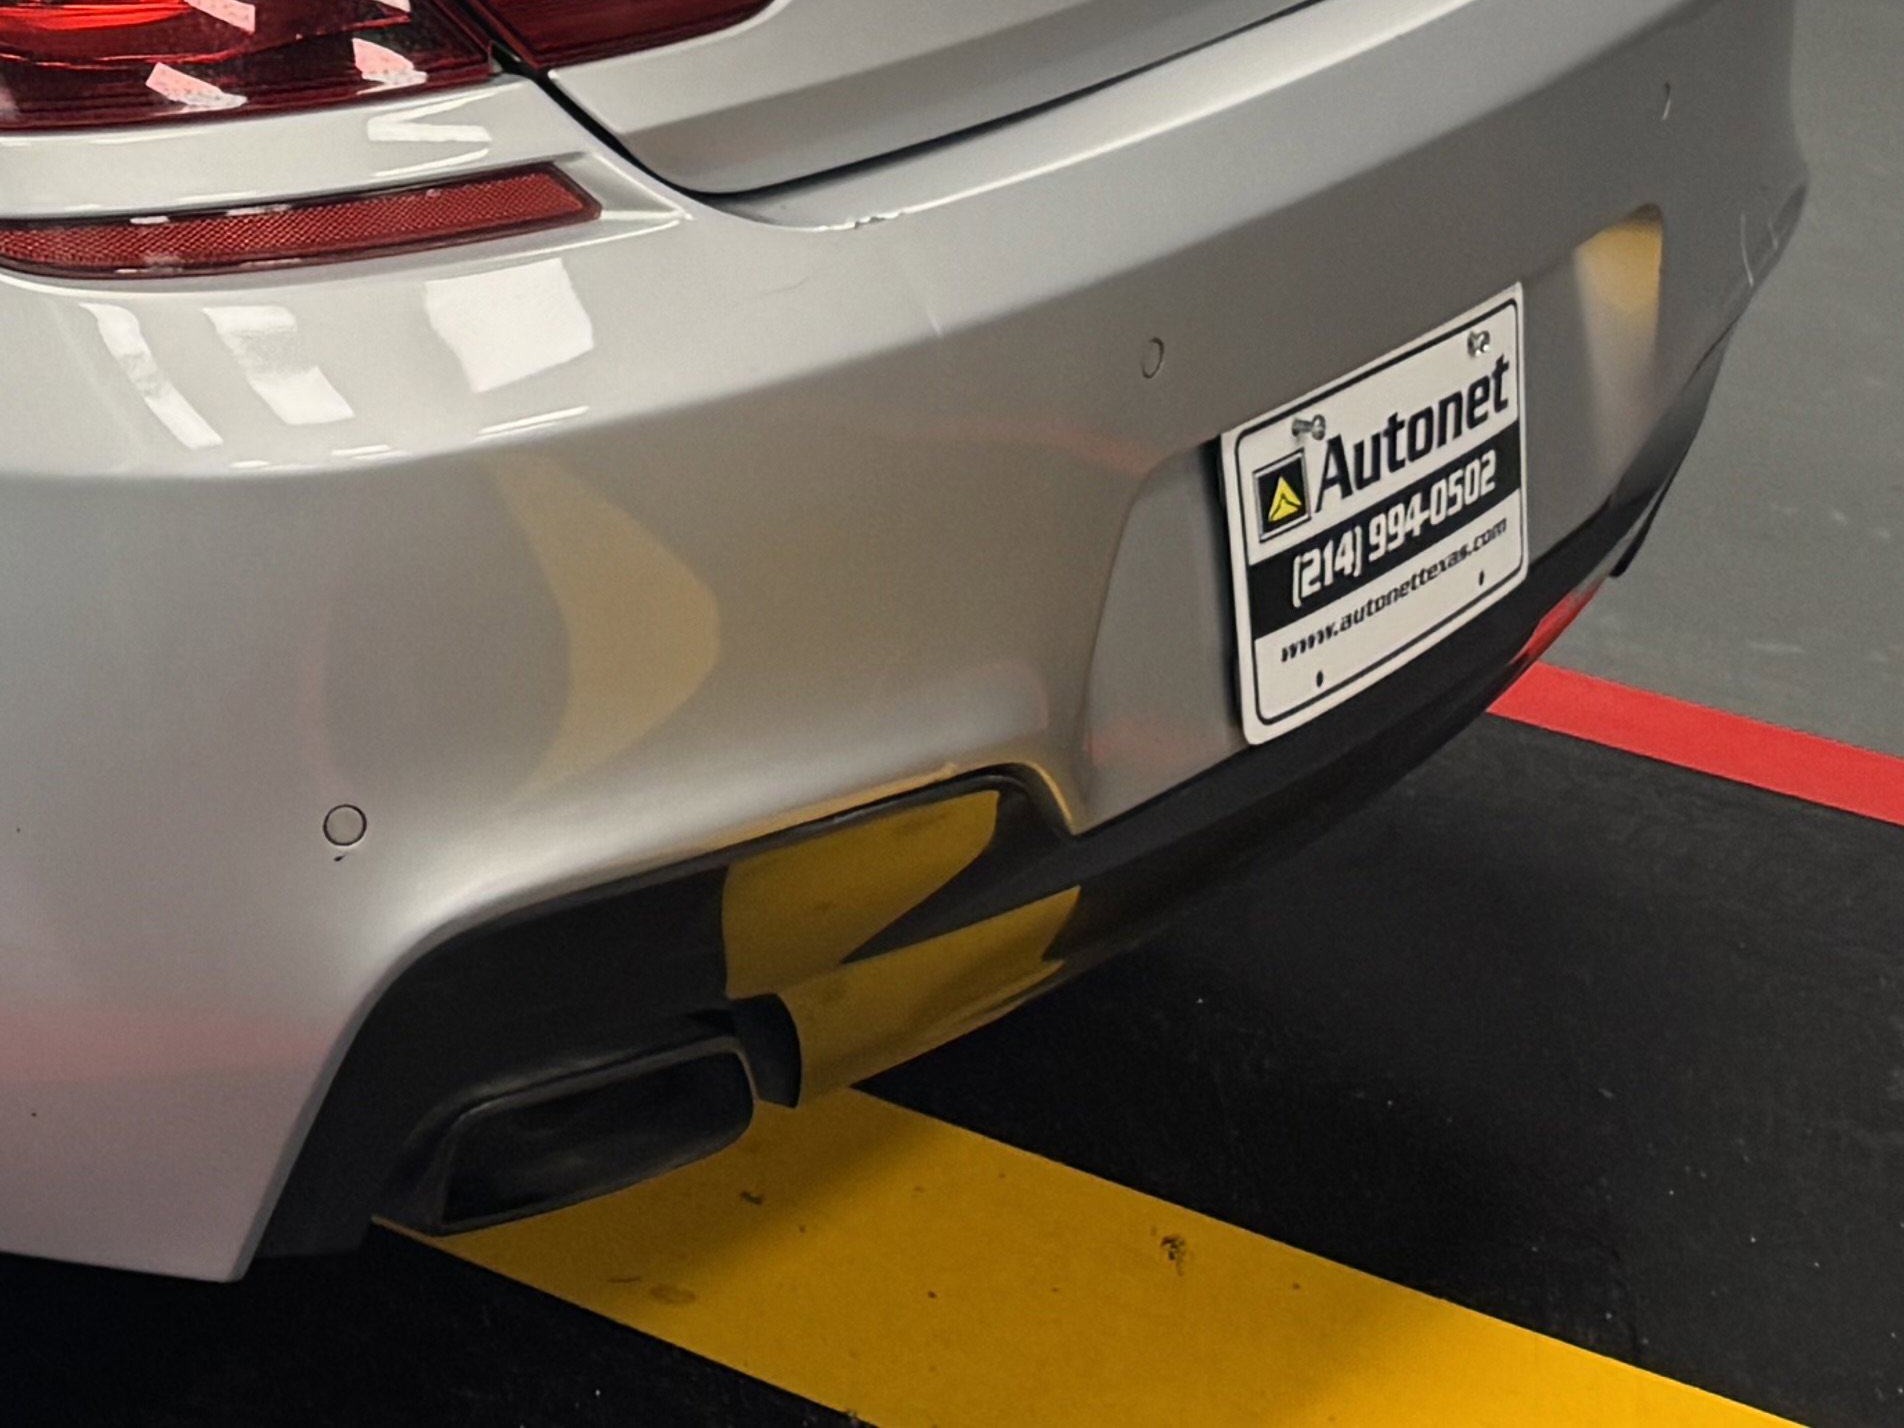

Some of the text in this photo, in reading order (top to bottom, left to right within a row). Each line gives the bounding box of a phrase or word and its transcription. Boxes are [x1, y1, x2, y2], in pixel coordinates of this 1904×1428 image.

[1314, 353, 1510, 514] Autonet
[1280, 517, 1509, 663] www.autonettexas.com
[1291, 449, 1497, 609] (214) 994-0502
